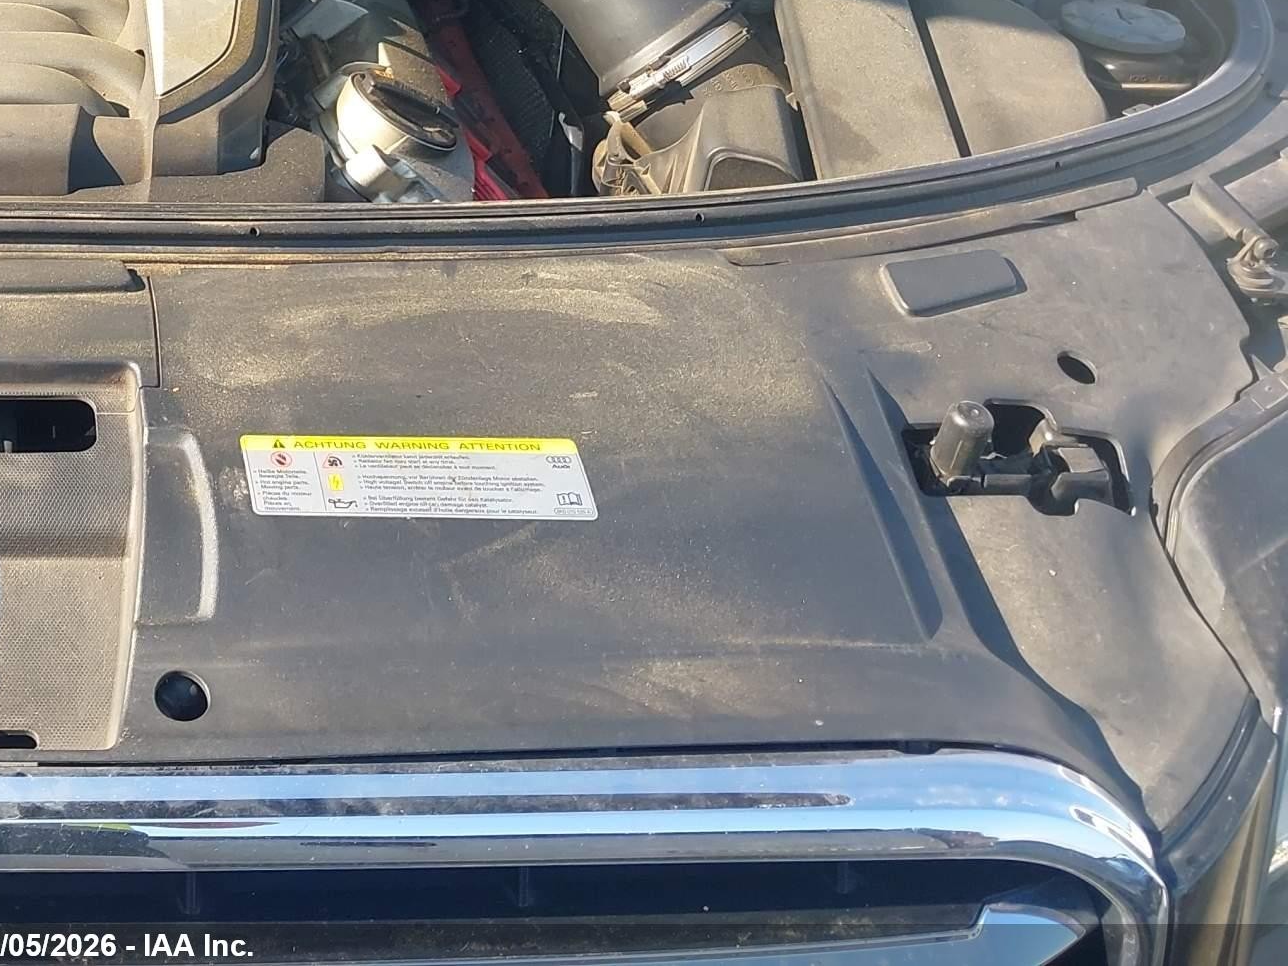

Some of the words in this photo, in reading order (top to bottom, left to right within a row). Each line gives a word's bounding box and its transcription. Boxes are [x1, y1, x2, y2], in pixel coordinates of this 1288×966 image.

[293, 441, 367, 449] ACHTUNG
[374, 441, 450, 450] WARNING
[459, 442, 541, 451] ATTENTION
